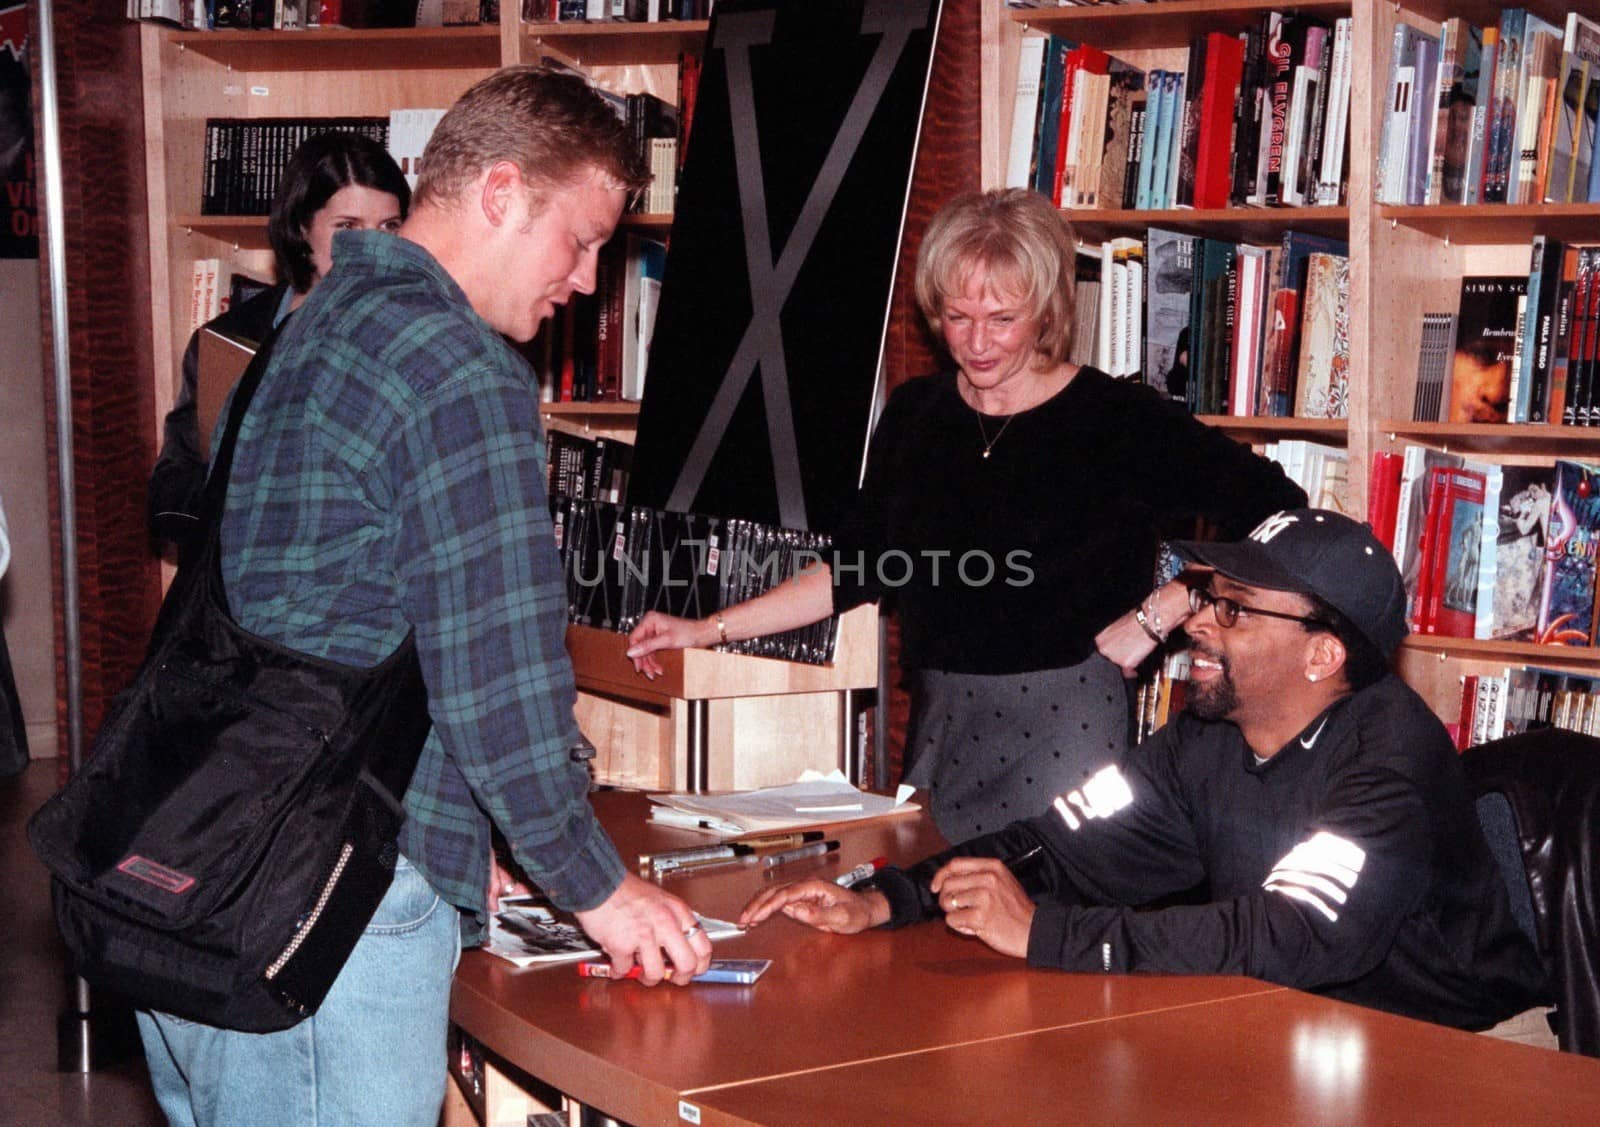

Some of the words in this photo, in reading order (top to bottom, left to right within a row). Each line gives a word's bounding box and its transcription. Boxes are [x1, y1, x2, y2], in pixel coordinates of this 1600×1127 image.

[1275, 42, 1291, 77] GIL
[1268, 82, 1288, 173] ELVGREN
[1465, 283, 1503, 293] SIMON
[1541, 315, 1550, 343] PAULA
[1538, 345, 1548, 369] REGO
